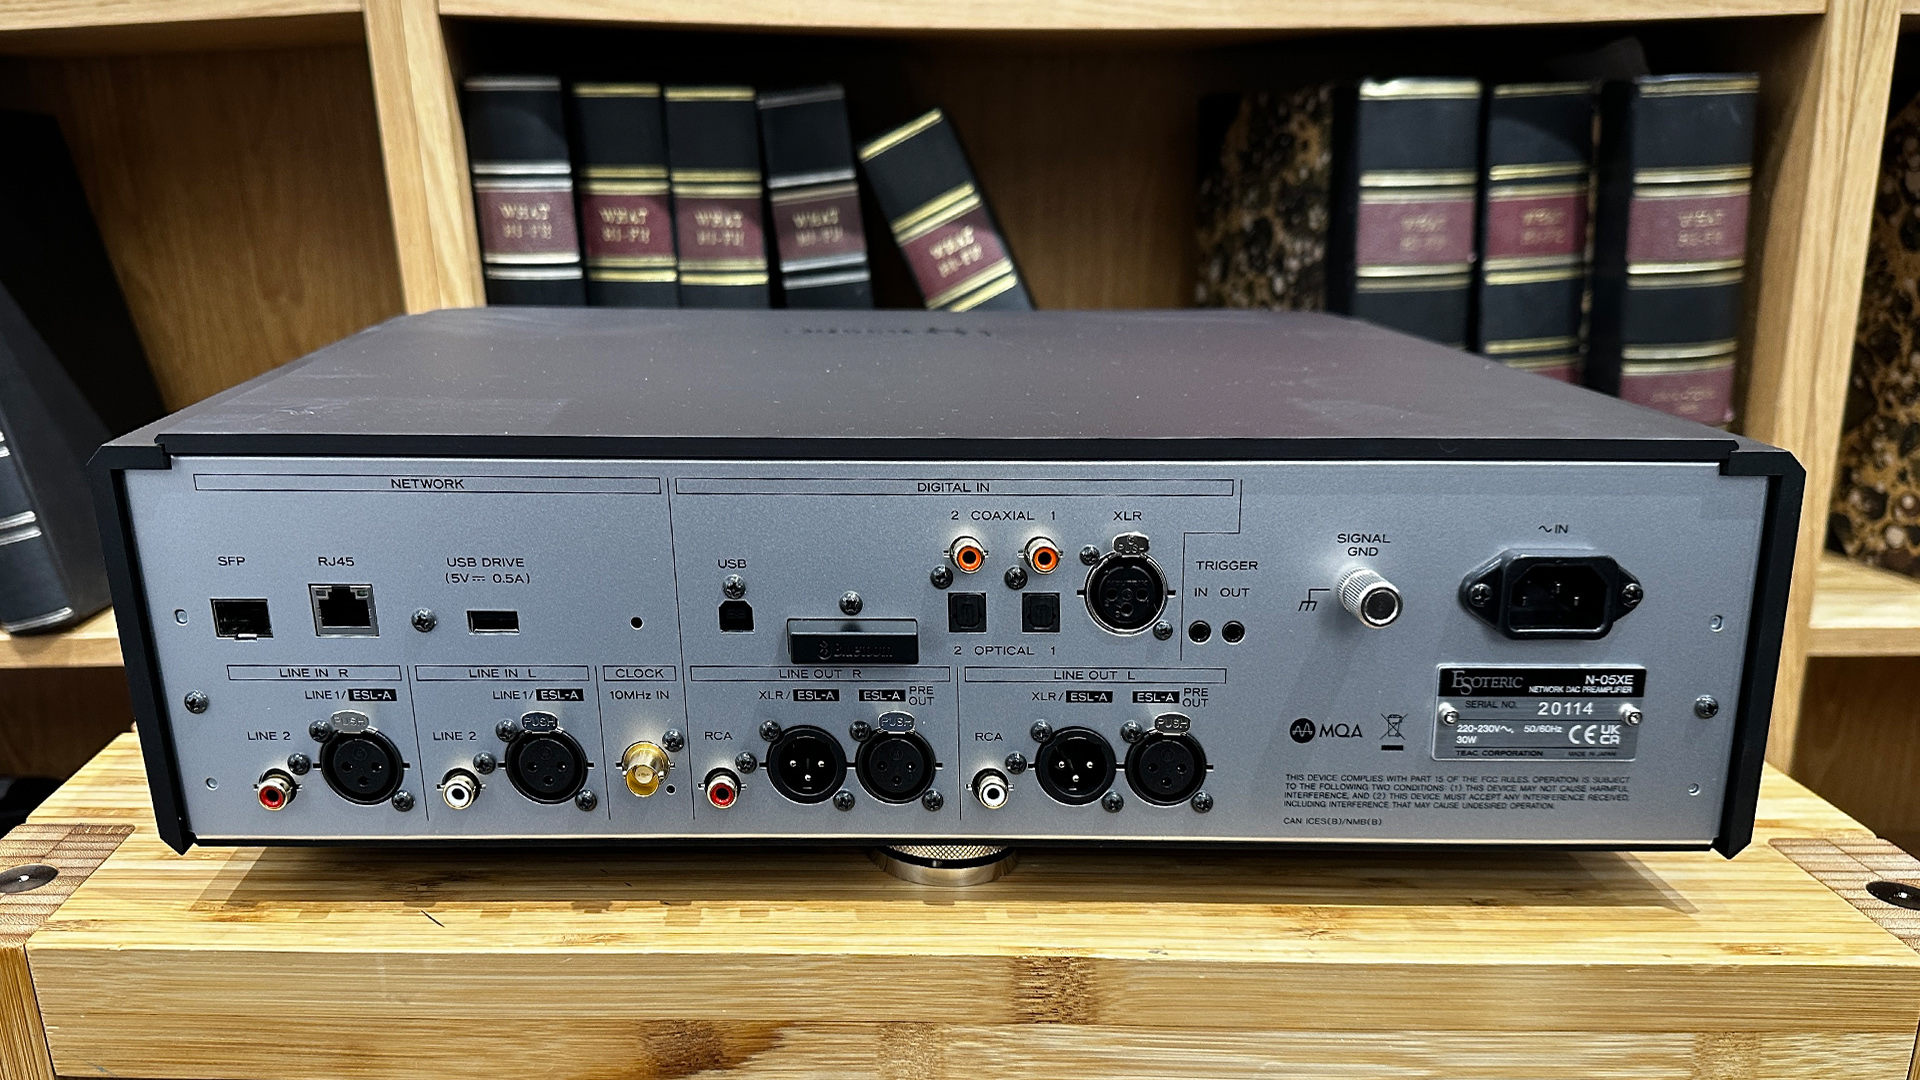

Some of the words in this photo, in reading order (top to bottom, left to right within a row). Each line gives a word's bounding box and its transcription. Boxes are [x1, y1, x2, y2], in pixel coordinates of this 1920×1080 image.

[390, 478, 465, 490] NETWORK
[917, 482, 971, 493] DIGITAL
[976, 482, 990, 493] IN
[951, 511, 959, 521] 2
[971, 511, 1035, 521] COAXIAL
[1051, 511, 1056, 521] 1
[1113, 511, 1142, 521] XLR
[1337, 533, 1391, 544] SIGNAL
[1347, 546, 1379, 557] GND
[217, 555, 246, 567] SFP
[317, 556, 355, 567] RJ45
[446, 556, 477, 568] USB
[482, 556, 525, 568] DRIVE
[717, 559, 747, 569] USB
[1196, 560, 1258, 571] TRIGGER
[492, 573, 531, 585] 0.5A)
[1194, 588, 1208, 598] IN
[1219, 588, 1250, 598] OUT
[954, 646, 962, 656] 2
[974, 646, 1035, 656] OPTICAL
[1051, 646, 1056, 656] 1
[279, 668, 309, 678] LINE
[315, 668, 329, 678] IN
[339, 668, 349, 678] R
[468, 668, 499, 678] LINE
[505, 668, 518, 678] IN
[528, 668, 537, 678] L
[615, 668, 664, 678] CLOCK
[779, 669, 810, 679] LINE
[813, 669, 842, 679] OUT
[853, 669, 862, 679] R
[1053, 670, 1085, 680] LINE
[1088, 670, 1117, 680] OUT
[1128, 670, 1136, 680] L
[1451, 670, 1524, 695] ESOTERIC
[1585, 675, 1634, 685] N-05XE
[610, 690, 651, 700] 10MHz
[656, 690, 669, 700] IN
[863, 690, 901, 700] ESL-A
[909, 685, 934, 695] PRE
[1183, 688, 1209, 697] PRE
[1582, 686, 1633, 694] PREAMPLIFIER
[908, 696, 935, 706] OUT
[1137, 692, 1175, 702] ESL-A
[1182, 698, 1209, 707] OUT
[1465, 700, 1498, 709] SERIAL
[1501, 701, 1517, 709] NO.
[1537, 702, 1594, 716] 20114
[333, 716, 366, 726] PUSH
[523, 716, 556, 727] PUSH
[880, 716, 914, 727] PUSH
[1157, 718, 1188, 729] PUSH
[1319, 724, 1363, 738] MQA
[1523, 725, 1563, 733] 50/60Hz
[1600, 725, 1620, 734] UK
[247, 731, 277, 741] LINE
[283, 731, 291, 741] 2
[433, 731, 463, 741] LINE
[469, 731, 477, 741] 2
[704, 731, 733, 741] RCA
[975, 732, 1003, 742] RCA
[1456, 735, 1477, 744] 30W
[1568, 725, 1598, 744] CE
[1286, 774, 1304, 782] THIS
[1308, 774, 1337, 782] DEVICE
[1341, 774, 1383, 782] COMPLIES
[1386, 774, 1407, 782] WITH
[1410, 774, 1431, 782] PART
[1435, 774, 1444, 782] 15
[1447, 774, 1458, 782] OF
[1462, 775, 1477, 783] THE
[1481, 775, 1498, 783] FCC
[1532, 775, 1579, 783] OPERATION
[1582, 775, 1589, 783] IS
[1592, 775, 1630, 783] SUBJECT
[1285, 783, 1297, 791] TO
[1300, 783, 1316, 791] THE
[1319, 783, 1368, 791] FOLLOWING
[1371, 783, 1390, 791] TWO
[1450, 784, 1462, 792] (1)
[1466, 784, 1484, 792] THIS
[1487, 784, 1517, 792] DEVICE
[1519, 784, 1536, 792] MAY
[1539, 784, 1556, 792] NOT
[1559, 784, 1586, 792] CAUSE
[1589, 785, 1628, 793] HARMFUL
[1352, 792, 1369, 800] AND
[1372, 792, 1386, 800] (2)
[1390, 792, 1407, 800] THIS
[1410, 792, 1440, 800] DEVICE
[1443, 792, 1466, 800] MUST
[1469, 792, 1501, 800] ACCEPT
[1504, 793, 1520, 801] ANY
[1522, 793, 1584, 801] INTERFERENCE
[1284, 800, 1326, 808] INCLUDING
[1393, 801, 1411, 809] THAT
[1414, 801, 1430, 809] MAY
[1433, 801, 1459, 809] CAUSE
